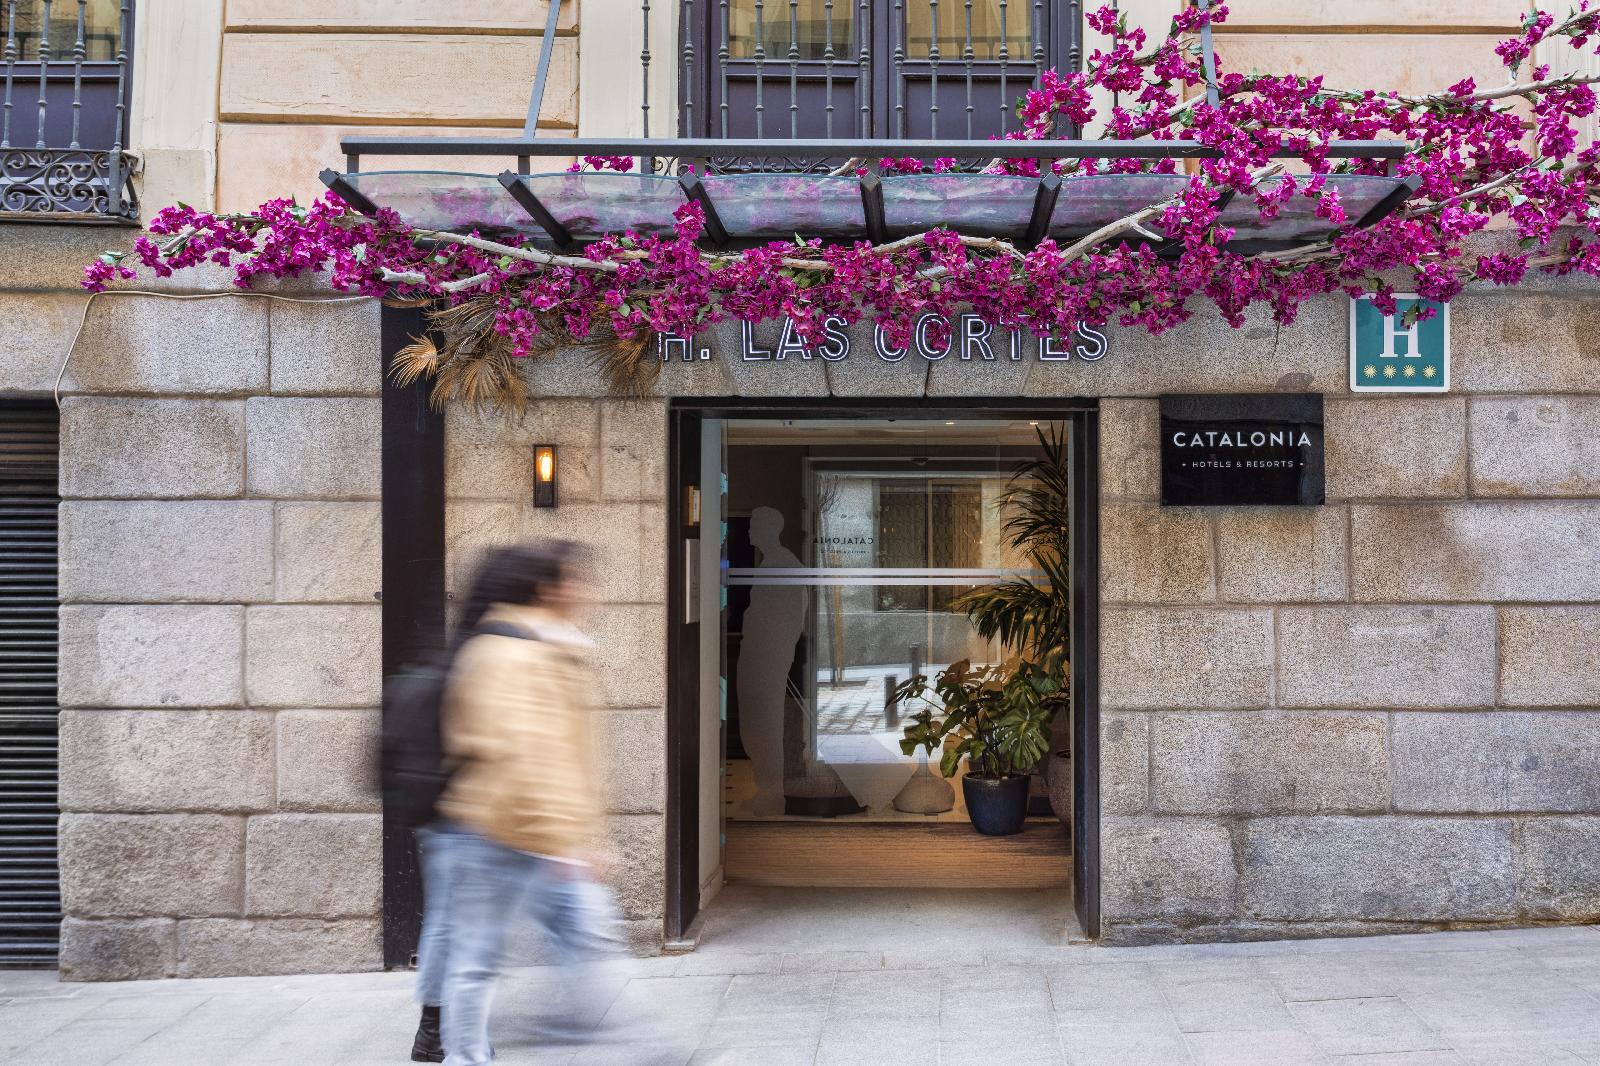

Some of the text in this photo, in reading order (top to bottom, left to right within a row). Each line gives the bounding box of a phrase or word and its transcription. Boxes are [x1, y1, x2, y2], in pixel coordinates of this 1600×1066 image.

[742, 314, 850, 361] LAS
[1379, 311, 1422, 358] H
[1173, 431, 1312, 447] CATALONIA
[1246, 460, 1294, 468] RESORTS
